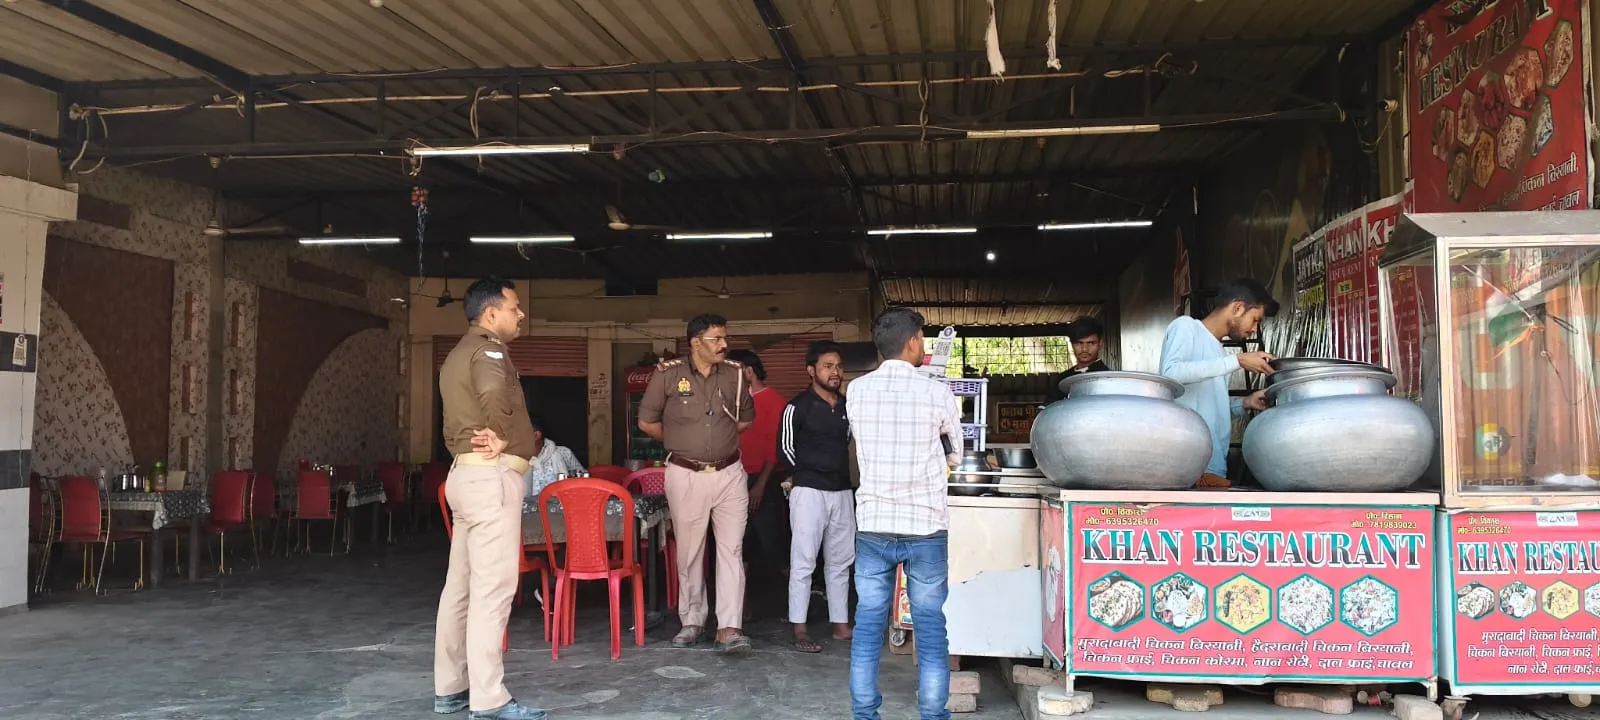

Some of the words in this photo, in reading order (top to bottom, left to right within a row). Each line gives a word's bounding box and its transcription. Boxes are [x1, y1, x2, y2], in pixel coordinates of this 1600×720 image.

[1327, 228, 1363, 263] KHAN
[1081, 528, 1184, 565] KHAN
[1193, 529, 1425, 569] RESTAURANT
[1457, 541, 1519, 575] KHAN
[1524, 540, 1600, 575] RESTAU
[1529, 628, 1557, 641] चिकन
[1145, 637, 1185, 650] चिकन
[1313, 640, 1353, 653] चिकन
[1467, 645, 1495, 657] चिकन
[1542, 645, 1570, 657] चिकन
[1082, 651, 1122, 664] चिकन
[1161, 653, 1200, 665] चिकन
[1253, 657, 1282, 667] नान
[1318, 658, 1342, 669] दाल
[1508, 664, 1527, 674] नान
[1553, 664, 1570, 675] दाल
